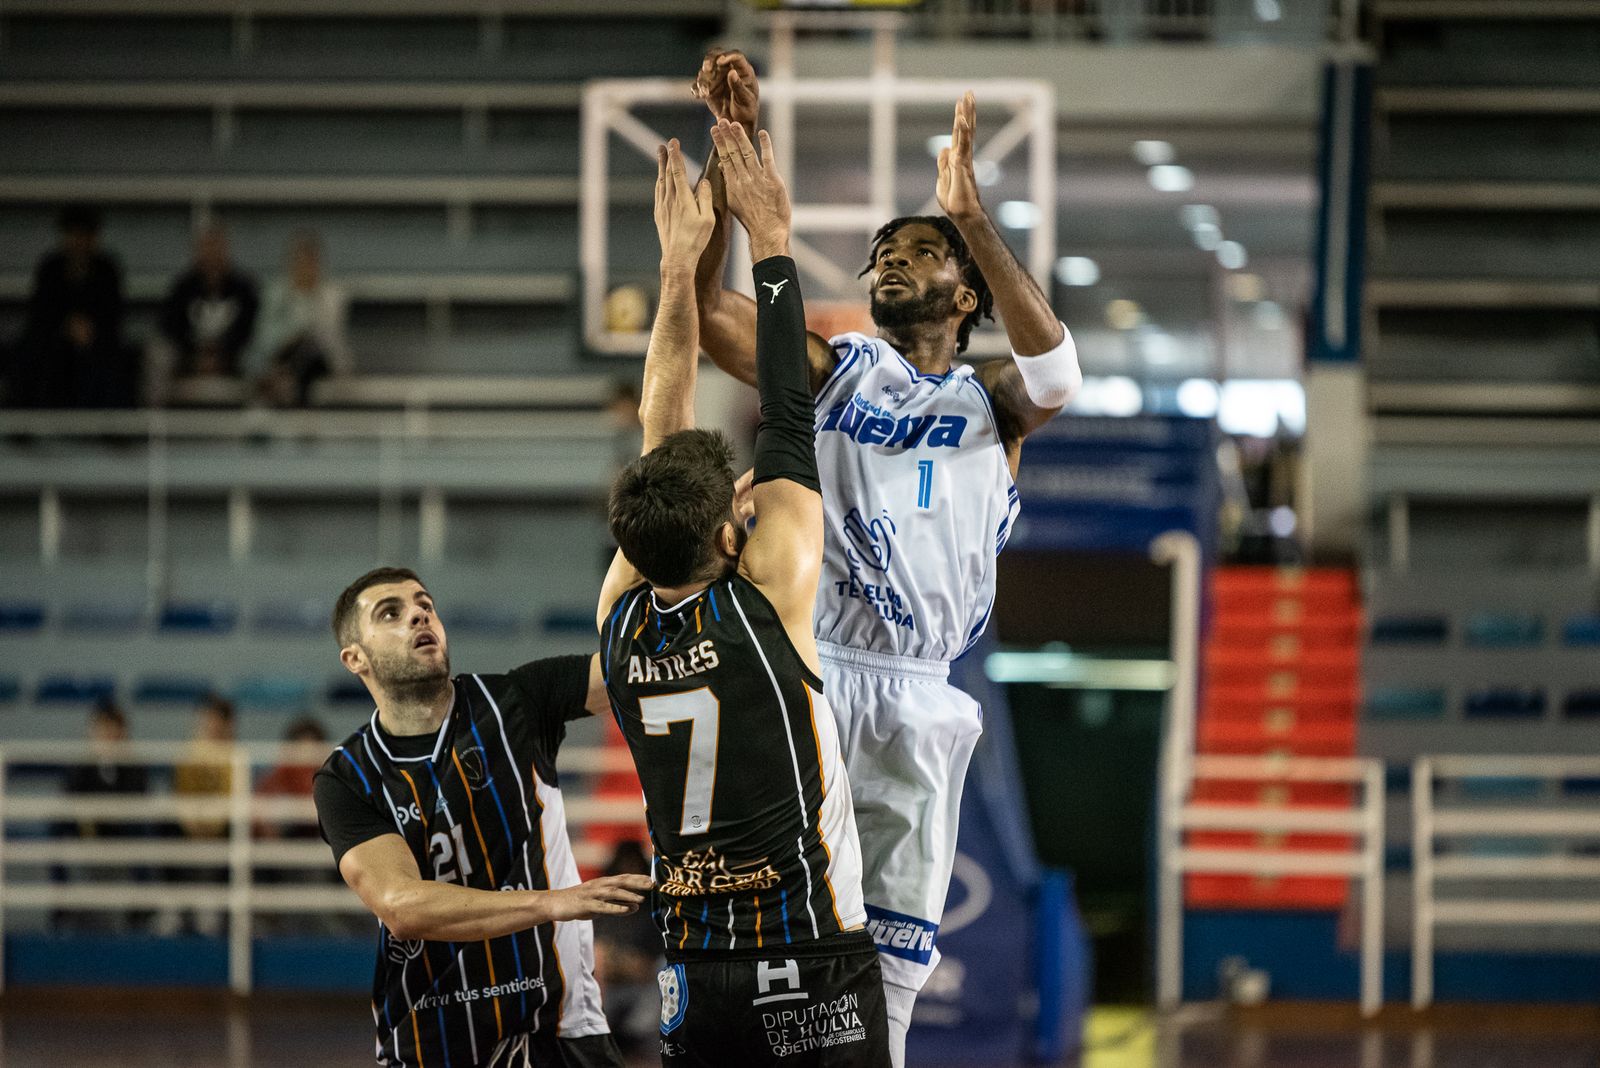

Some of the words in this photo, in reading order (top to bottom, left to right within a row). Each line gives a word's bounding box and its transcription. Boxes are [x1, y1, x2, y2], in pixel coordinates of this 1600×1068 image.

[917, 459, 934, 509] 1
[637, 685, 721, 837] 7
[429, 823, 473, 883] 21
[454, 988, 480, 1004] tus
[767, 1029, 792, 1046] DE
[799, 1011, 863, 1039] HULVA
